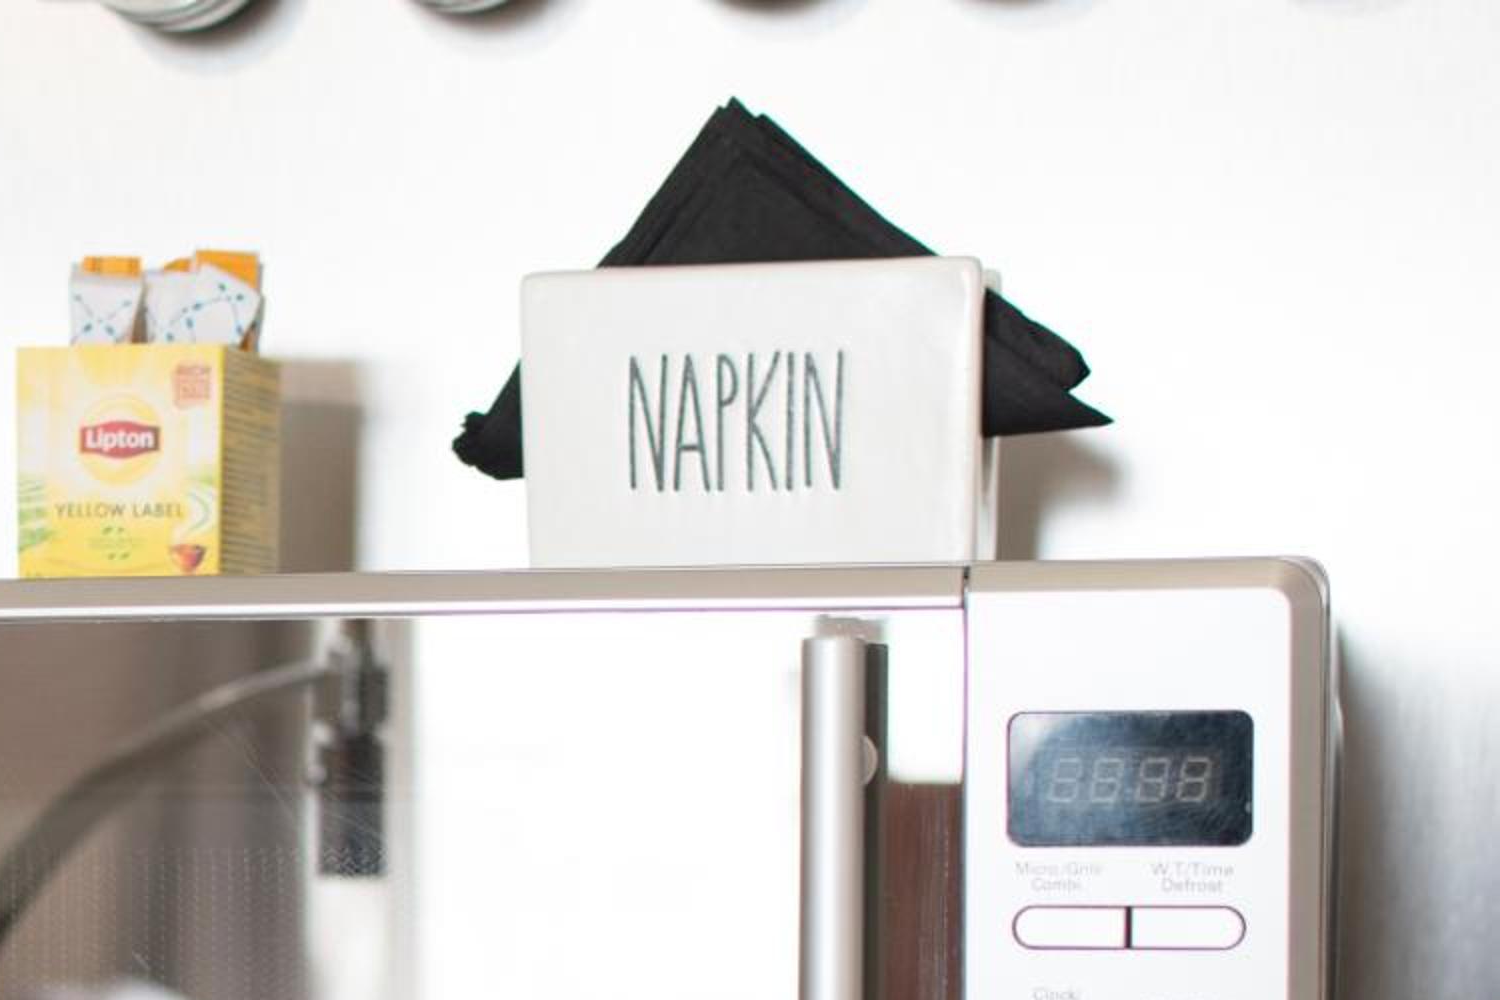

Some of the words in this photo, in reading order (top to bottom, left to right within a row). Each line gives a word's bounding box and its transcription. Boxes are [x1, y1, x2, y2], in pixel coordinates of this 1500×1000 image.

[629, 349, 843, 492] NAPKIN
[85, 427, 155, 450] Lipton
[54, 502, 126, 518] YELLOW
[133, 502, 184, 518] LABEL
[1161, 877, 1224, 893] Defrost
